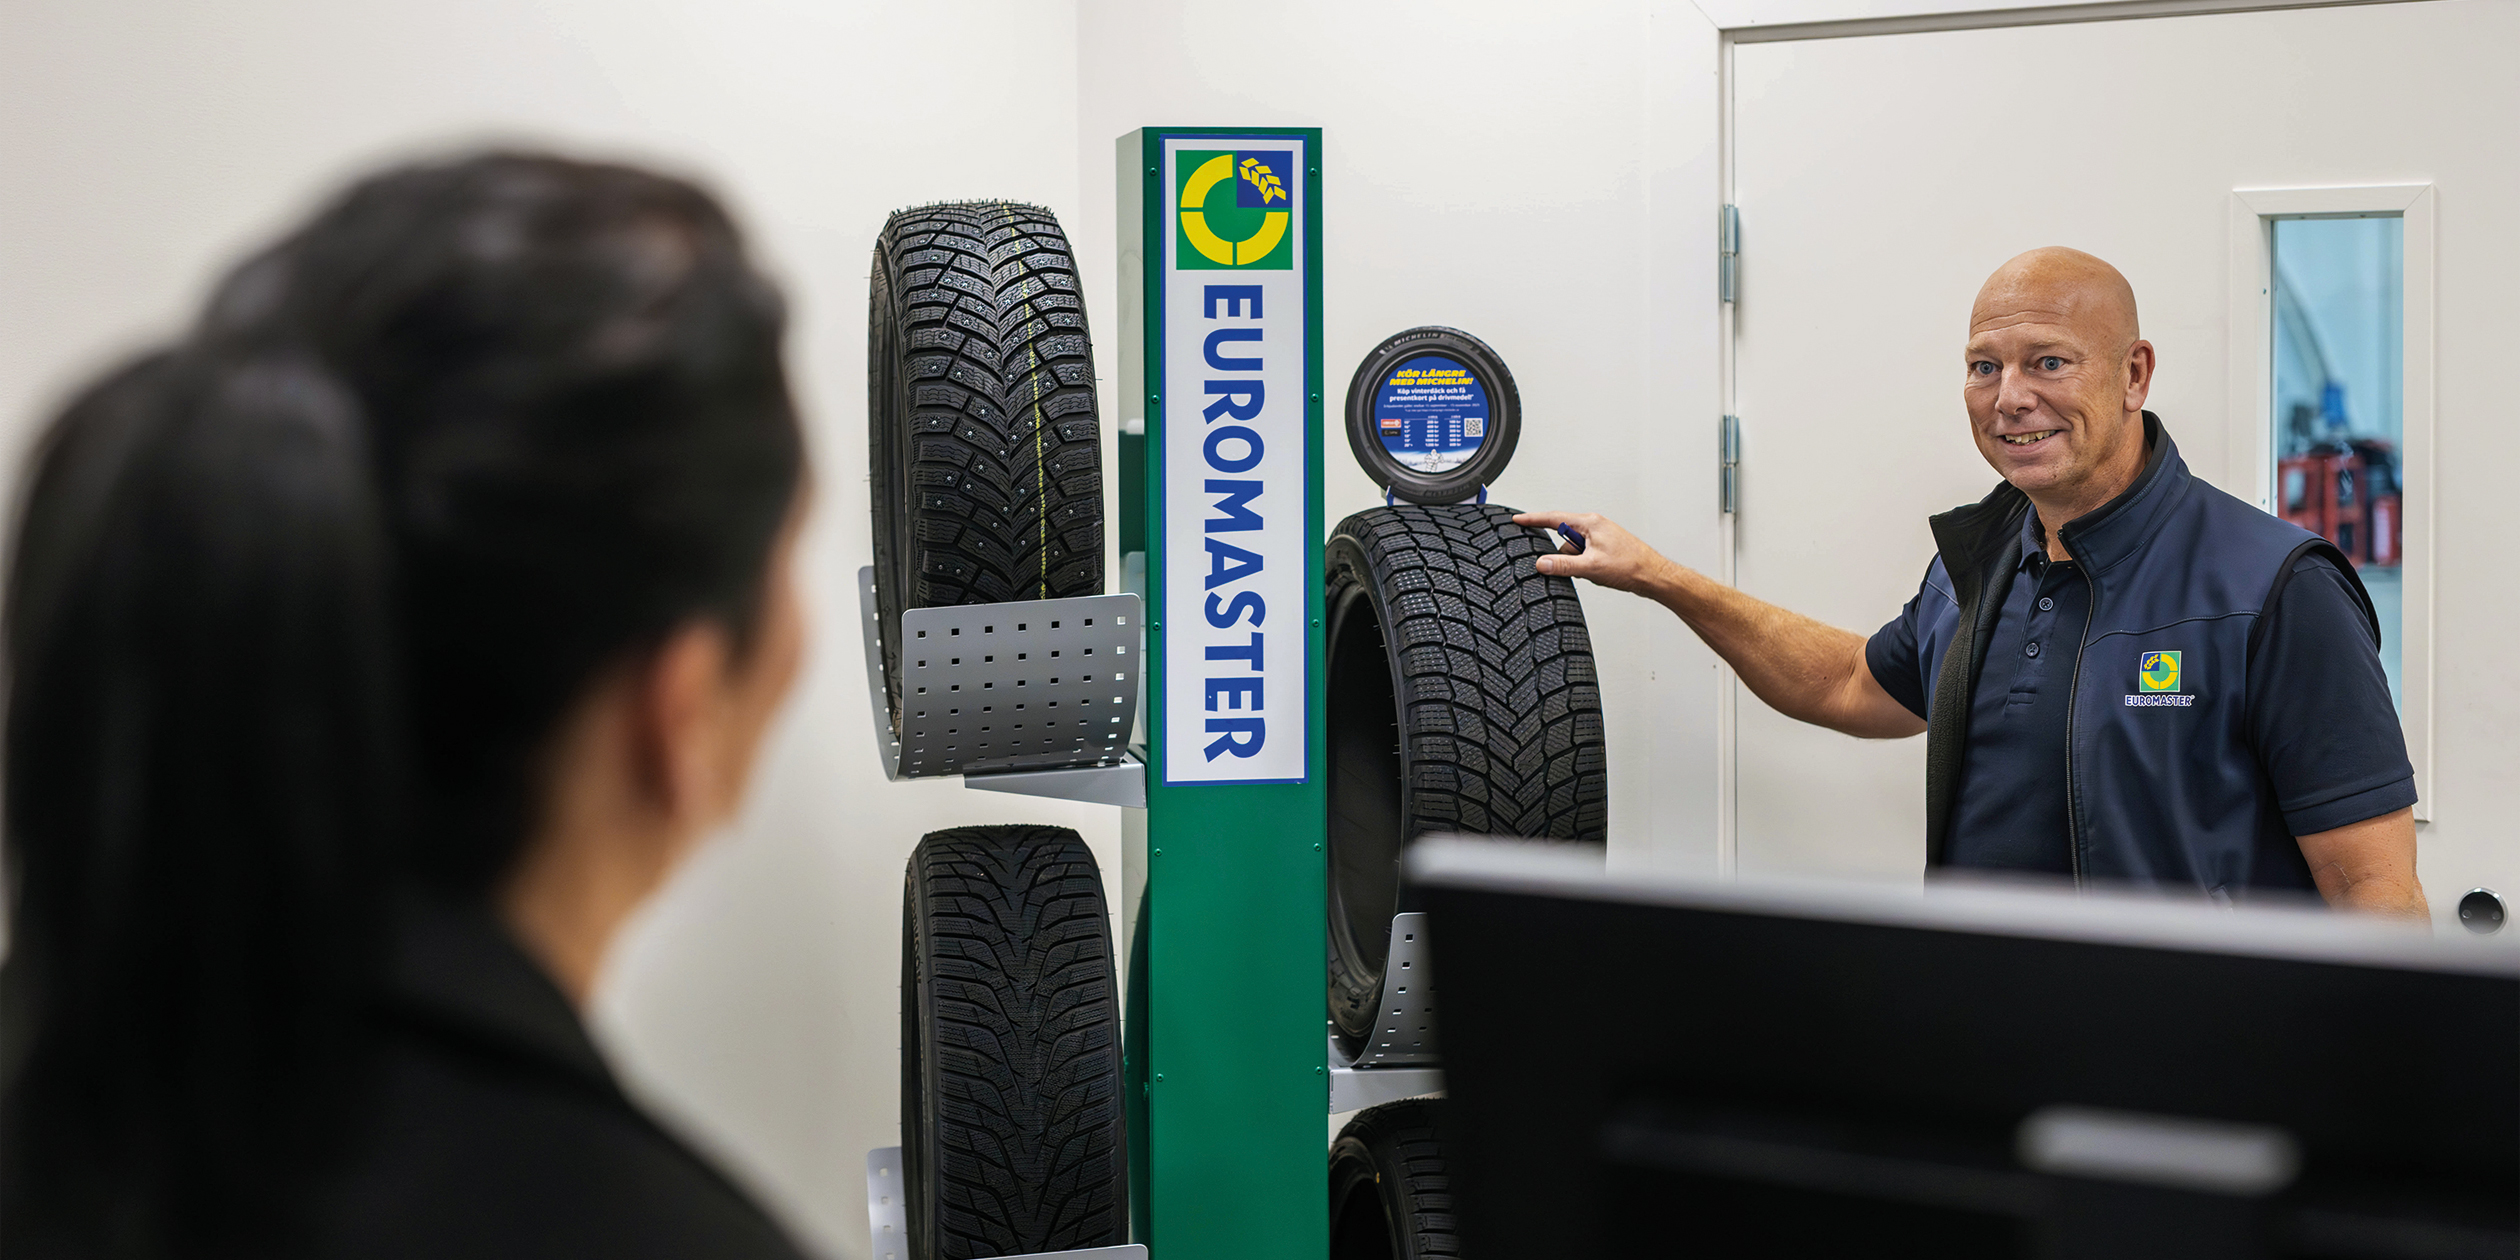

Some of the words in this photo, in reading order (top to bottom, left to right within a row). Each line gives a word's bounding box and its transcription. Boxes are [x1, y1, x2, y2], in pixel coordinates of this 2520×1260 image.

[1393, 332, 1440, 346] MICHELIN
[1397, 369, 1420, 378] KÖR
[1421, 369, 1467, 378] LÄNGRE
[1389, 378, 1415, 386] MED
[1416, 377, 1474, 386] MICHELIN!
[1429, 394, 1437, 402] på
[1203, 284, 1267, 763] EUROMASTER
